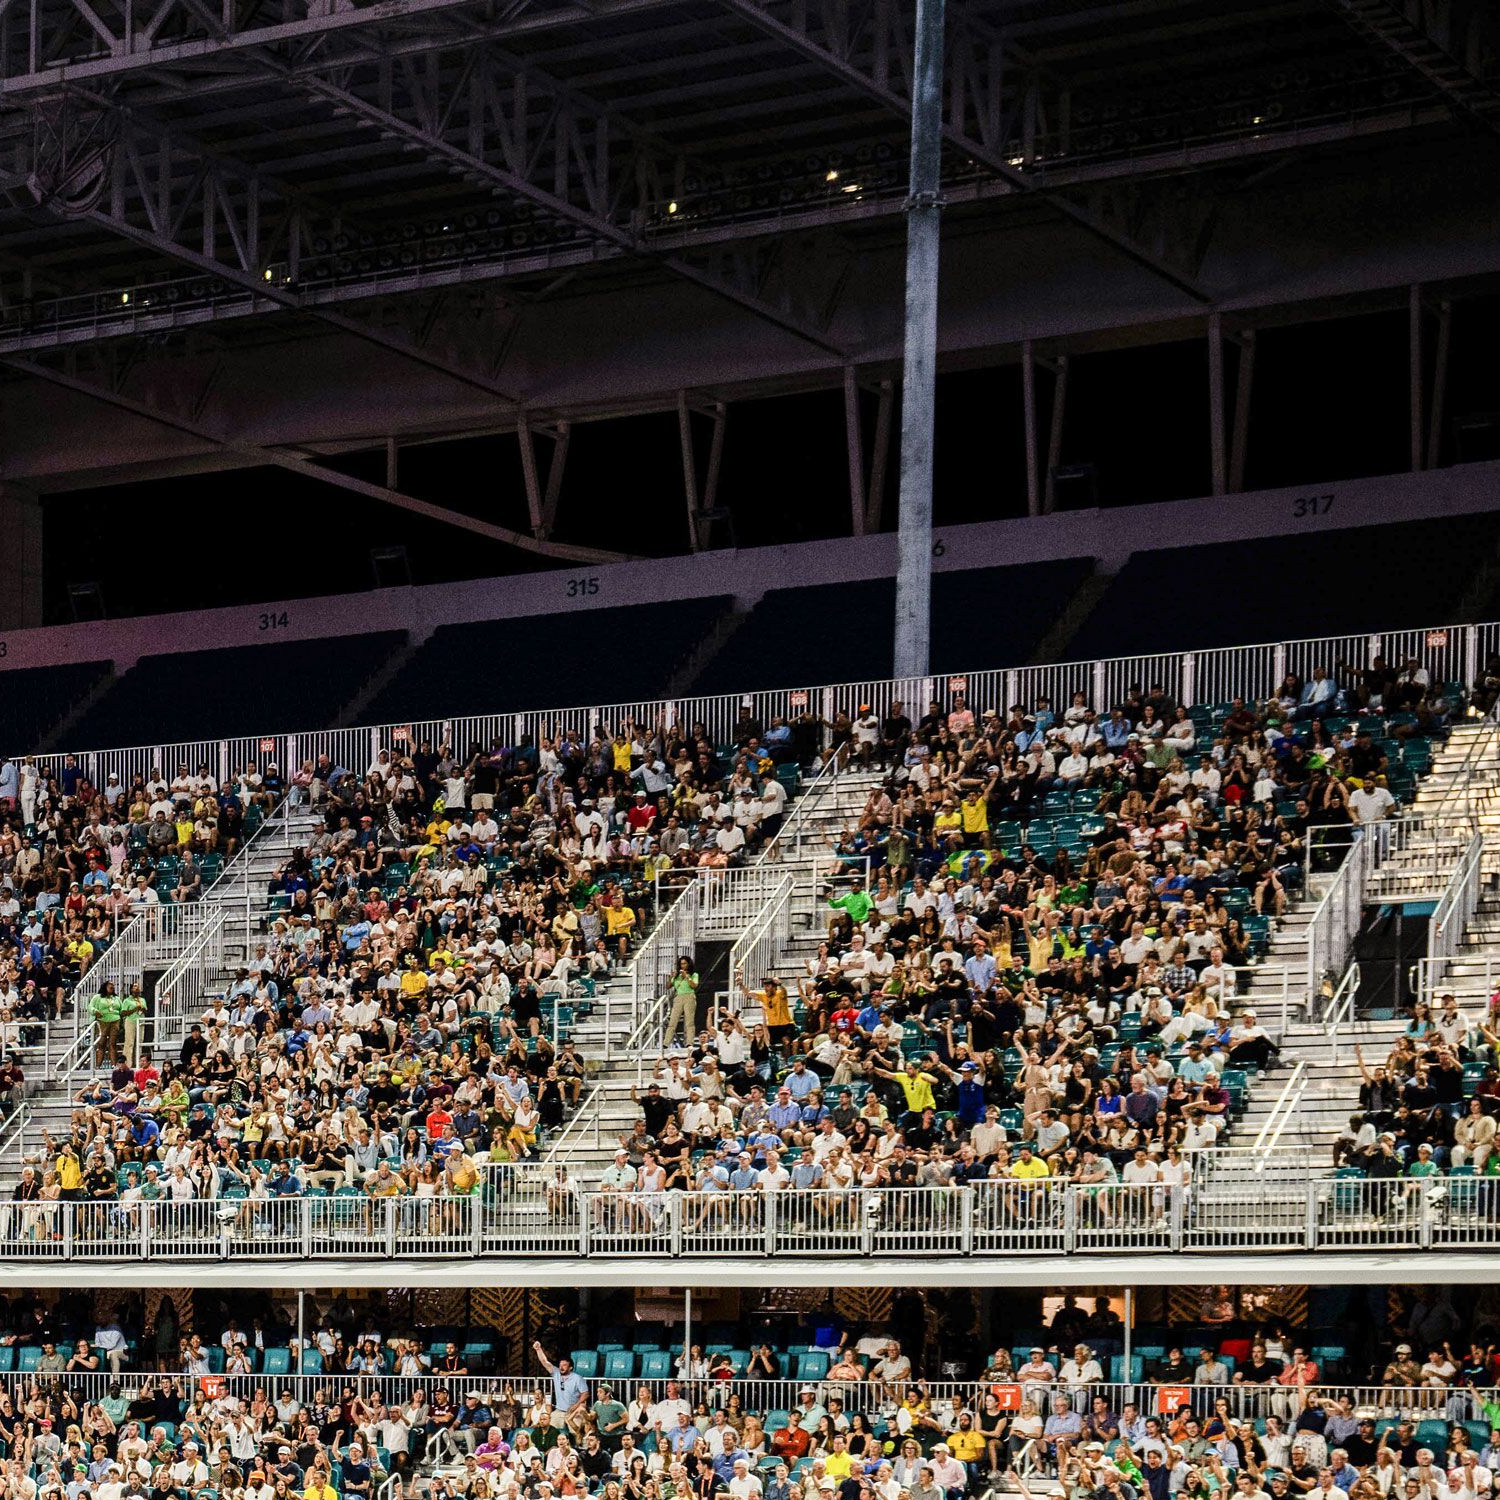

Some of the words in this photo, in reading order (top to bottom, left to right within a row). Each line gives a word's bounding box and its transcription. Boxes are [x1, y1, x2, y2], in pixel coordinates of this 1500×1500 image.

[1293, 494, 1335, 518] 317
[567, 577, 600, 597] 315
[258, 612, 289, 631] 314
[1427, 637, 1447, 647] 109
[949, 681, 967, 691] 109
[791, 696, 808, 705] 108
[392, 731, 407, 740] 108
[260, 743, 275, 752] 107
[207, 1384, 218, 1396] H
[1002, 1394, 1011, 1408] J
[1167, 1397, 1180, 1411] K
